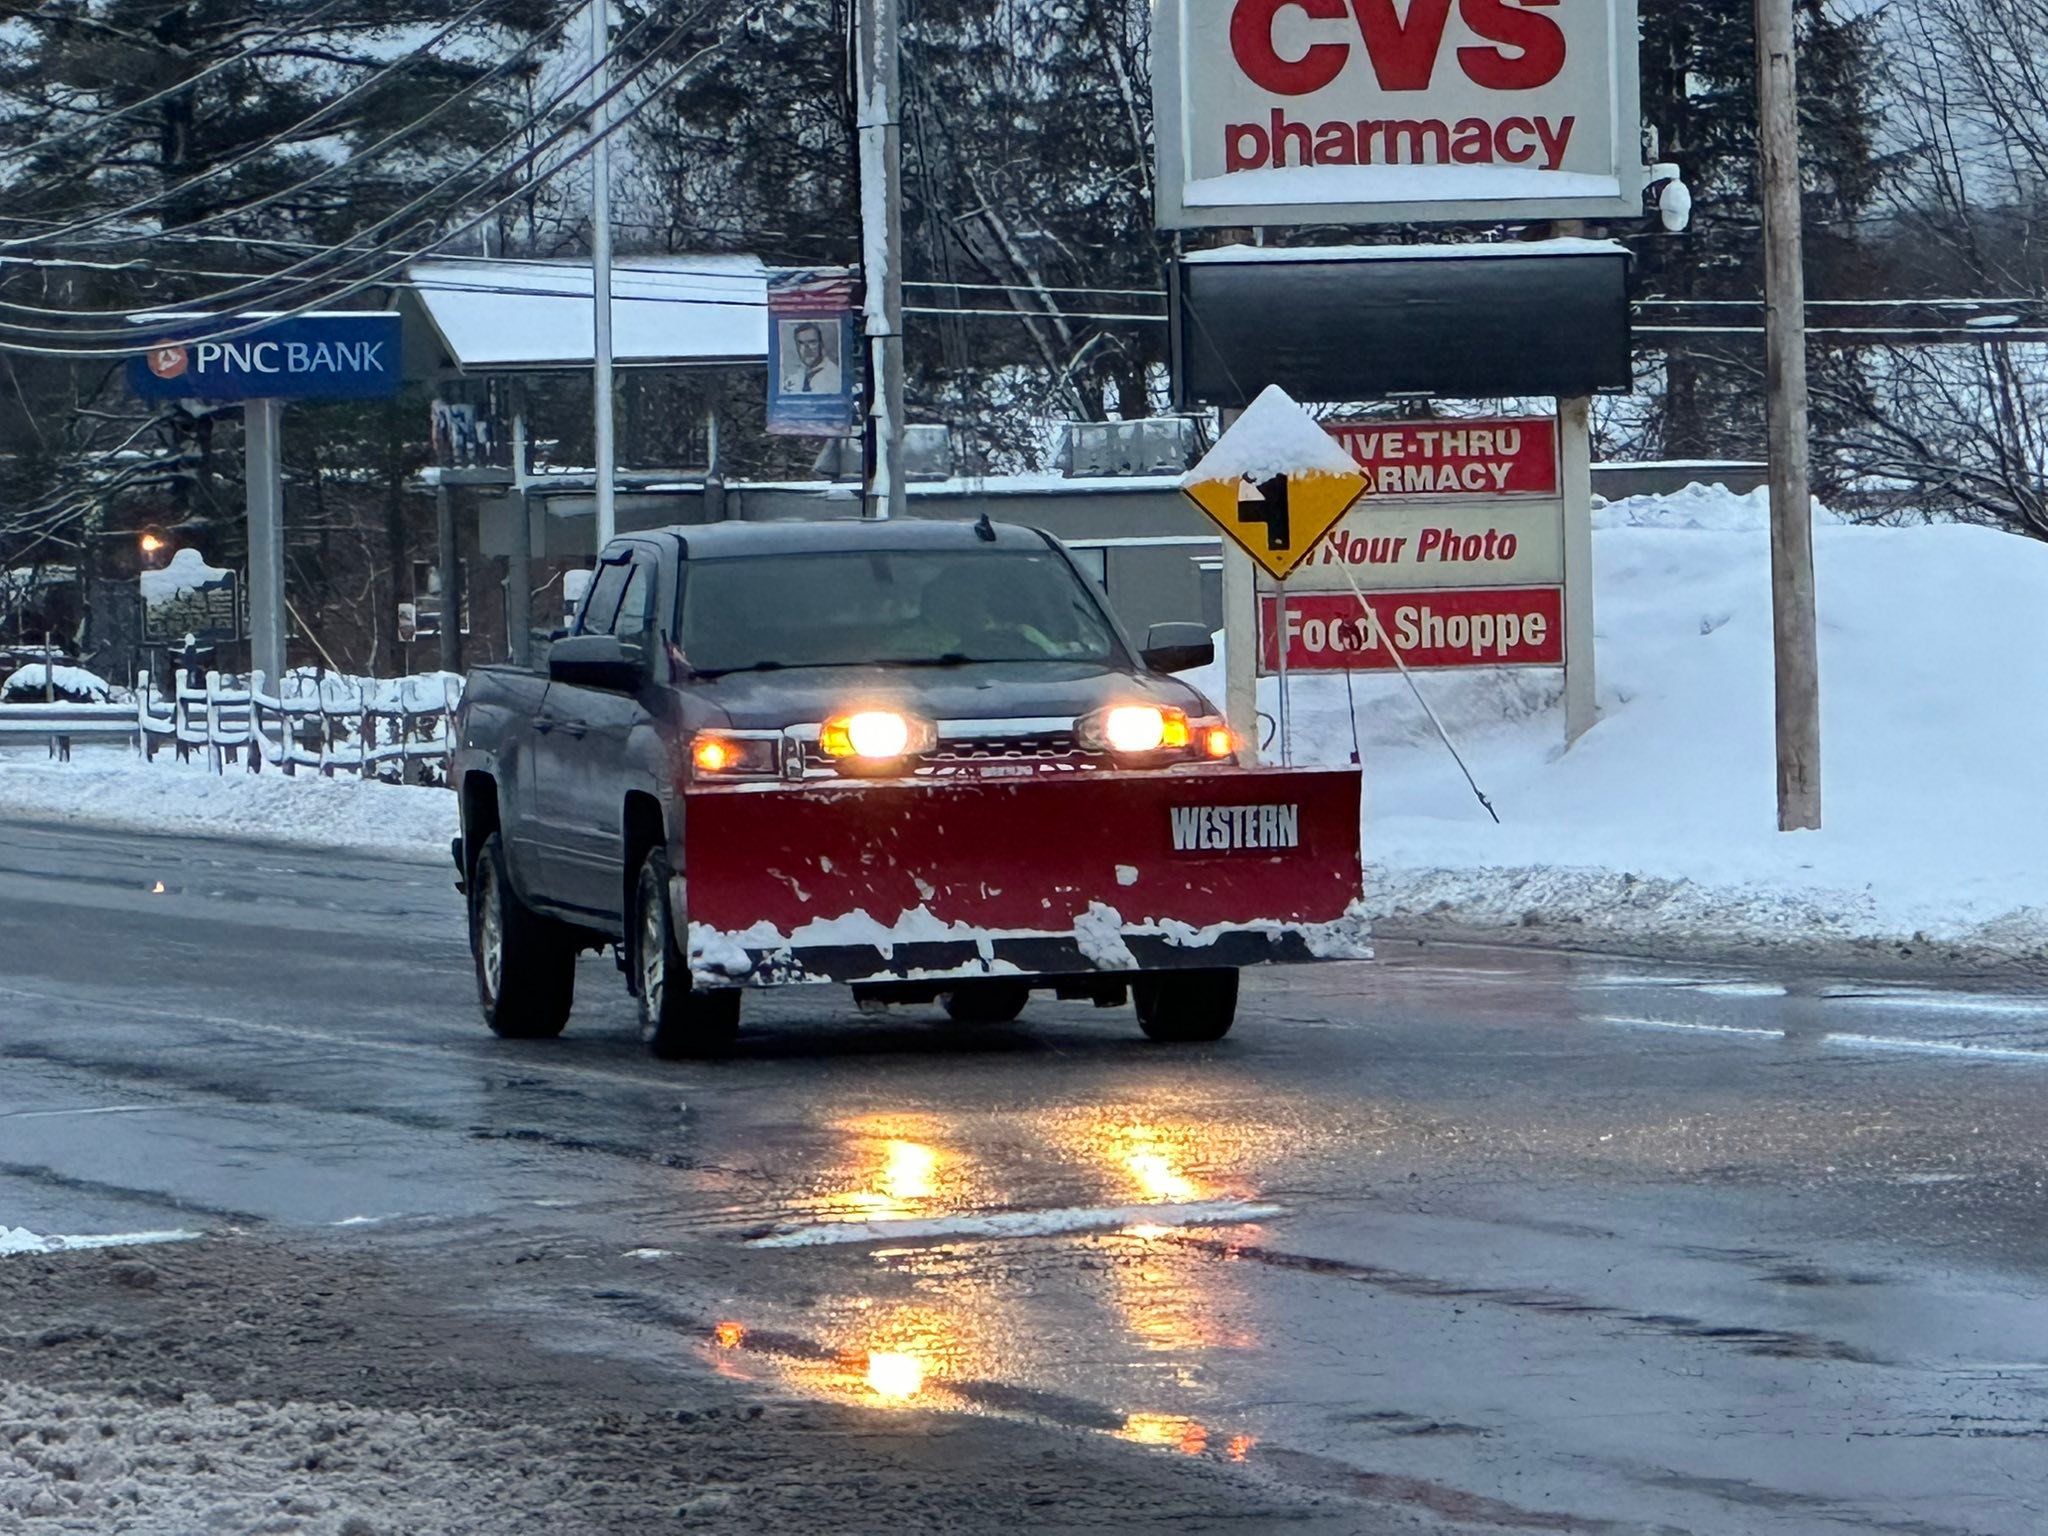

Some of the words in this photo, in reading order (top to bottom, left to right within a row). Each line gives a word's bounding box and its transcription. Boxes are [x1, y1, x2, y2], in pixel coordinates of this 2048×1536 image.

[1229, 0, 1566, 96] CVS
[1225, 107, 1576, 172] pharmacy
[282, 341, 385, 373] BANK
[1340, 428, 1521, 460] IVE-THRU
[1323, 529, 1407, 565] Hour
[1416, 527, 1518, 563] Photo
[1394, 606, 1548, 657] Shoppe
[1170, 804, 1299, 850] WESTERN
